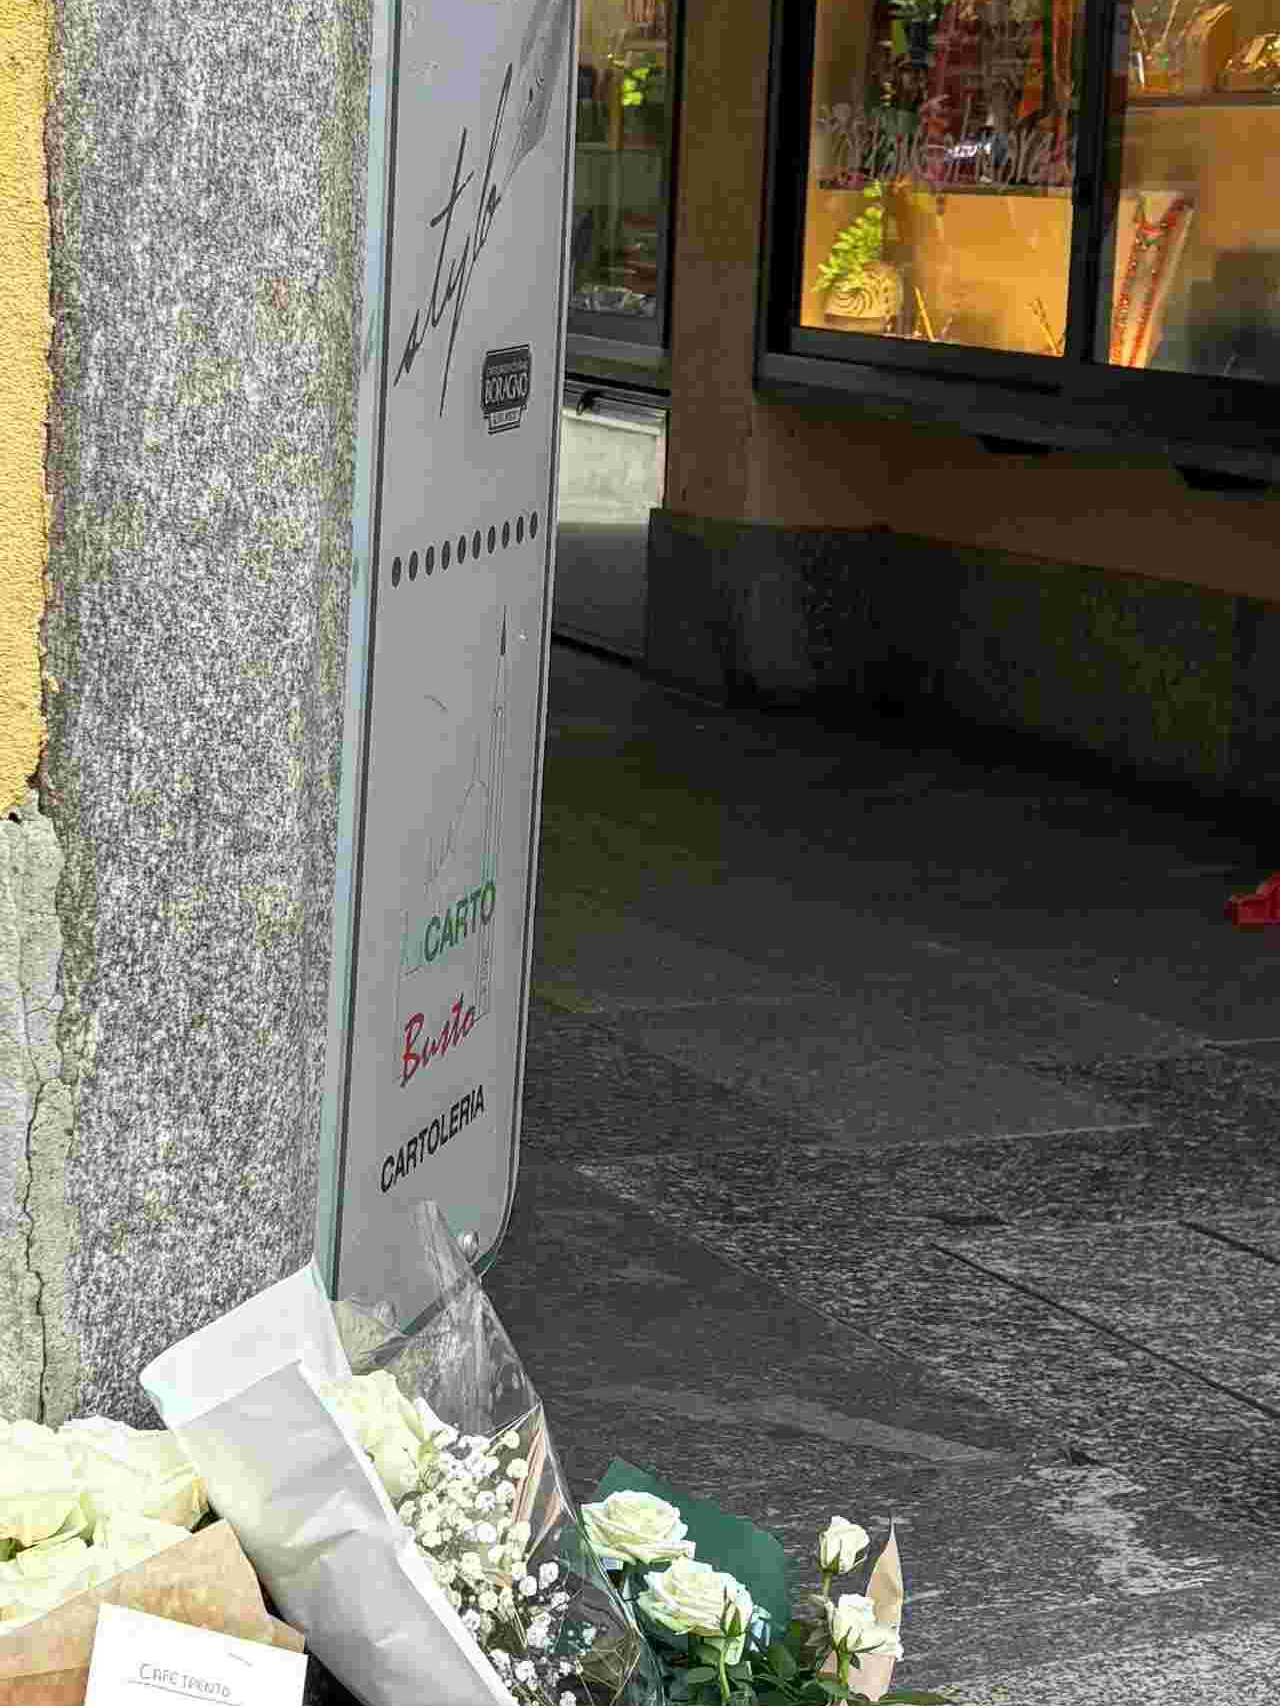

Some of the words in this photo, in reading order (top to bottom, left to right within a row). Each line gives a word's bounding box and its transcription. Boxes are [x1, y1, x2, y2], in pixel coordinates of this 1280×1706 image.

[424, 880, 496, 962] CARTO
[399, 992, 476, 1088] Busto
[380, 1085, 484, 1194] CARTOLERIA
